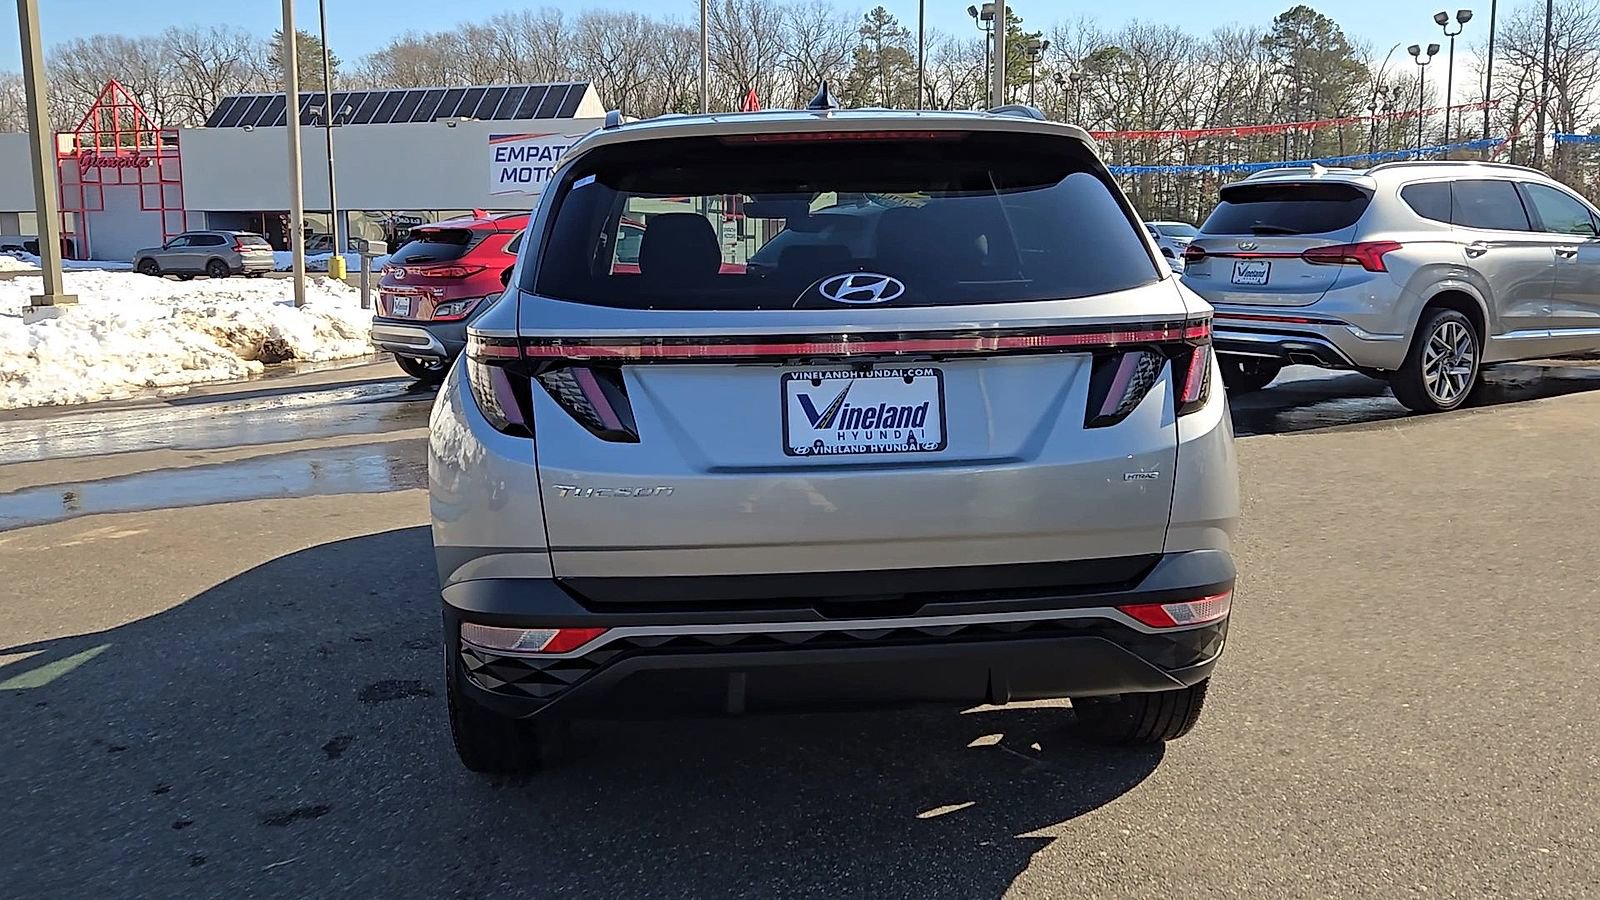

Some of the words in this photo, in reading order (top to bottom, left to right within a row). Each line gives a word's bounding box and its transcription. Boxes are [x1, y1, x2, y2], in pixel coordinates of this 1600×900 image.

[495, 146, 571, 162] EMPAT
[791, 368, 935, 380] VINELANDHYUNDAI.COM
[796, 380, 930, 430] Vineland
[837, 430, 925, 441] HYUNDAI
[812, 444, 867, 455] VINELAND
[870, 443, 920, 453] HYUNDAI
